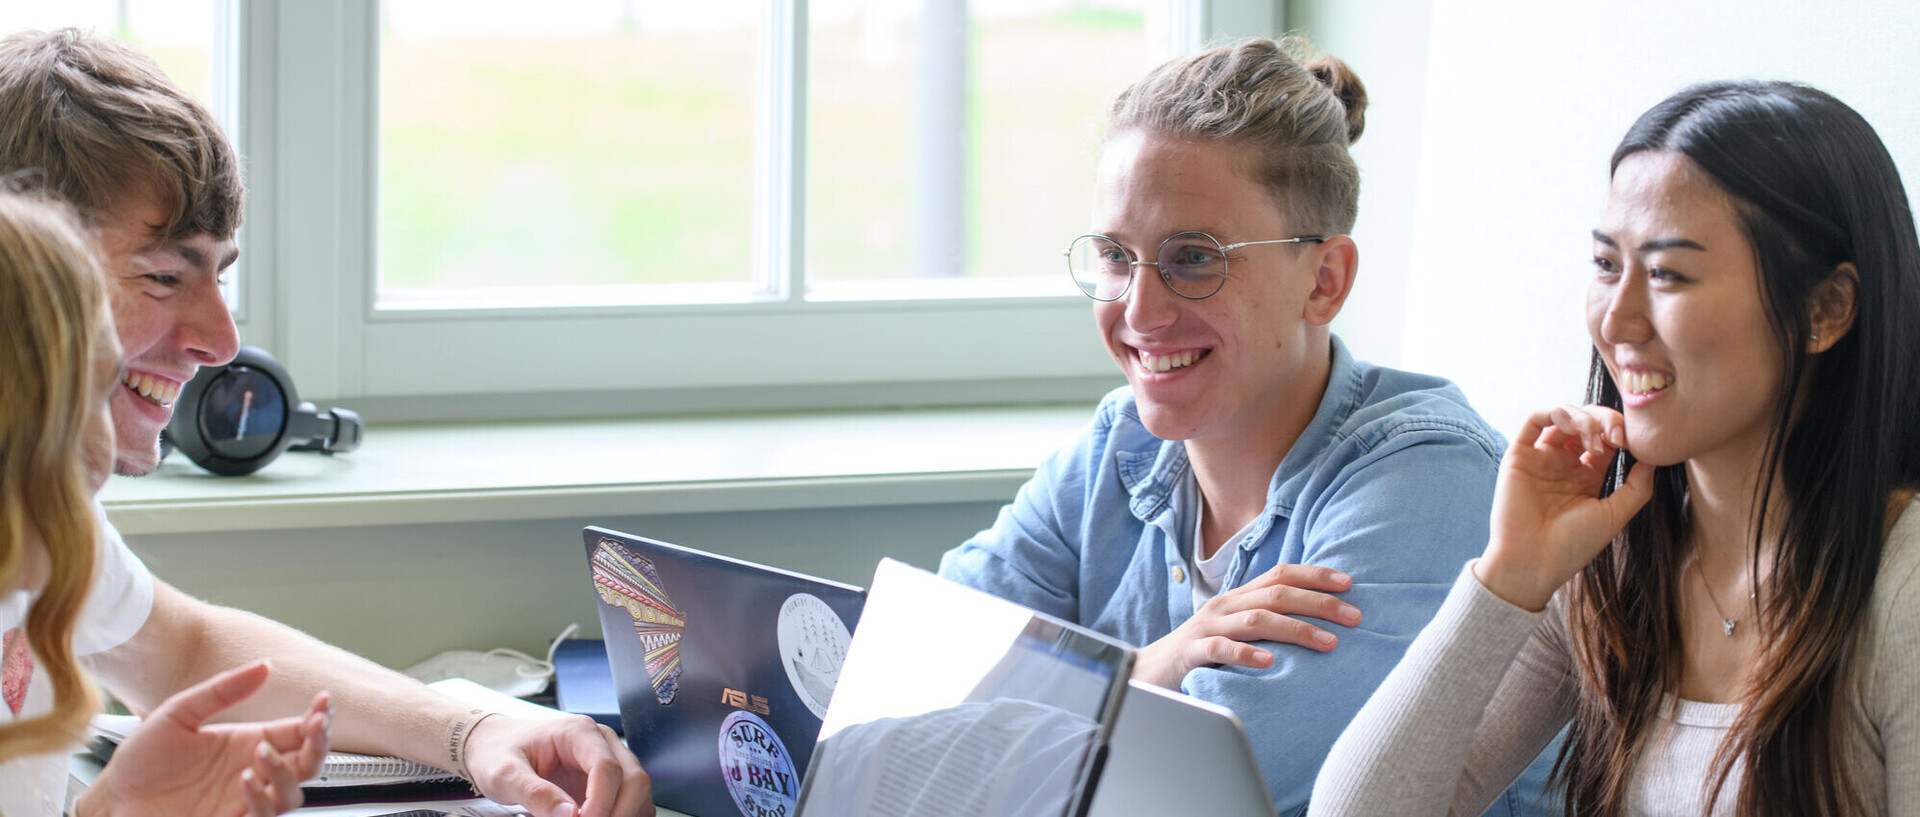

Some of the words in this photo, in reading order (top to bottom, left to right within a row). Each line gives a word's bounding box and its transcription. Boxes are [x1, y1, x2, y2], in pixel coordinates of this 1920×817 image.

[720, 687, 770, 716] ASUS
[731, 724, 779, 758] SURF
[731, 758, 742, 782] J
[746, 762, 791, 797] BAY
[743, 794, 786, 817] SHOP
